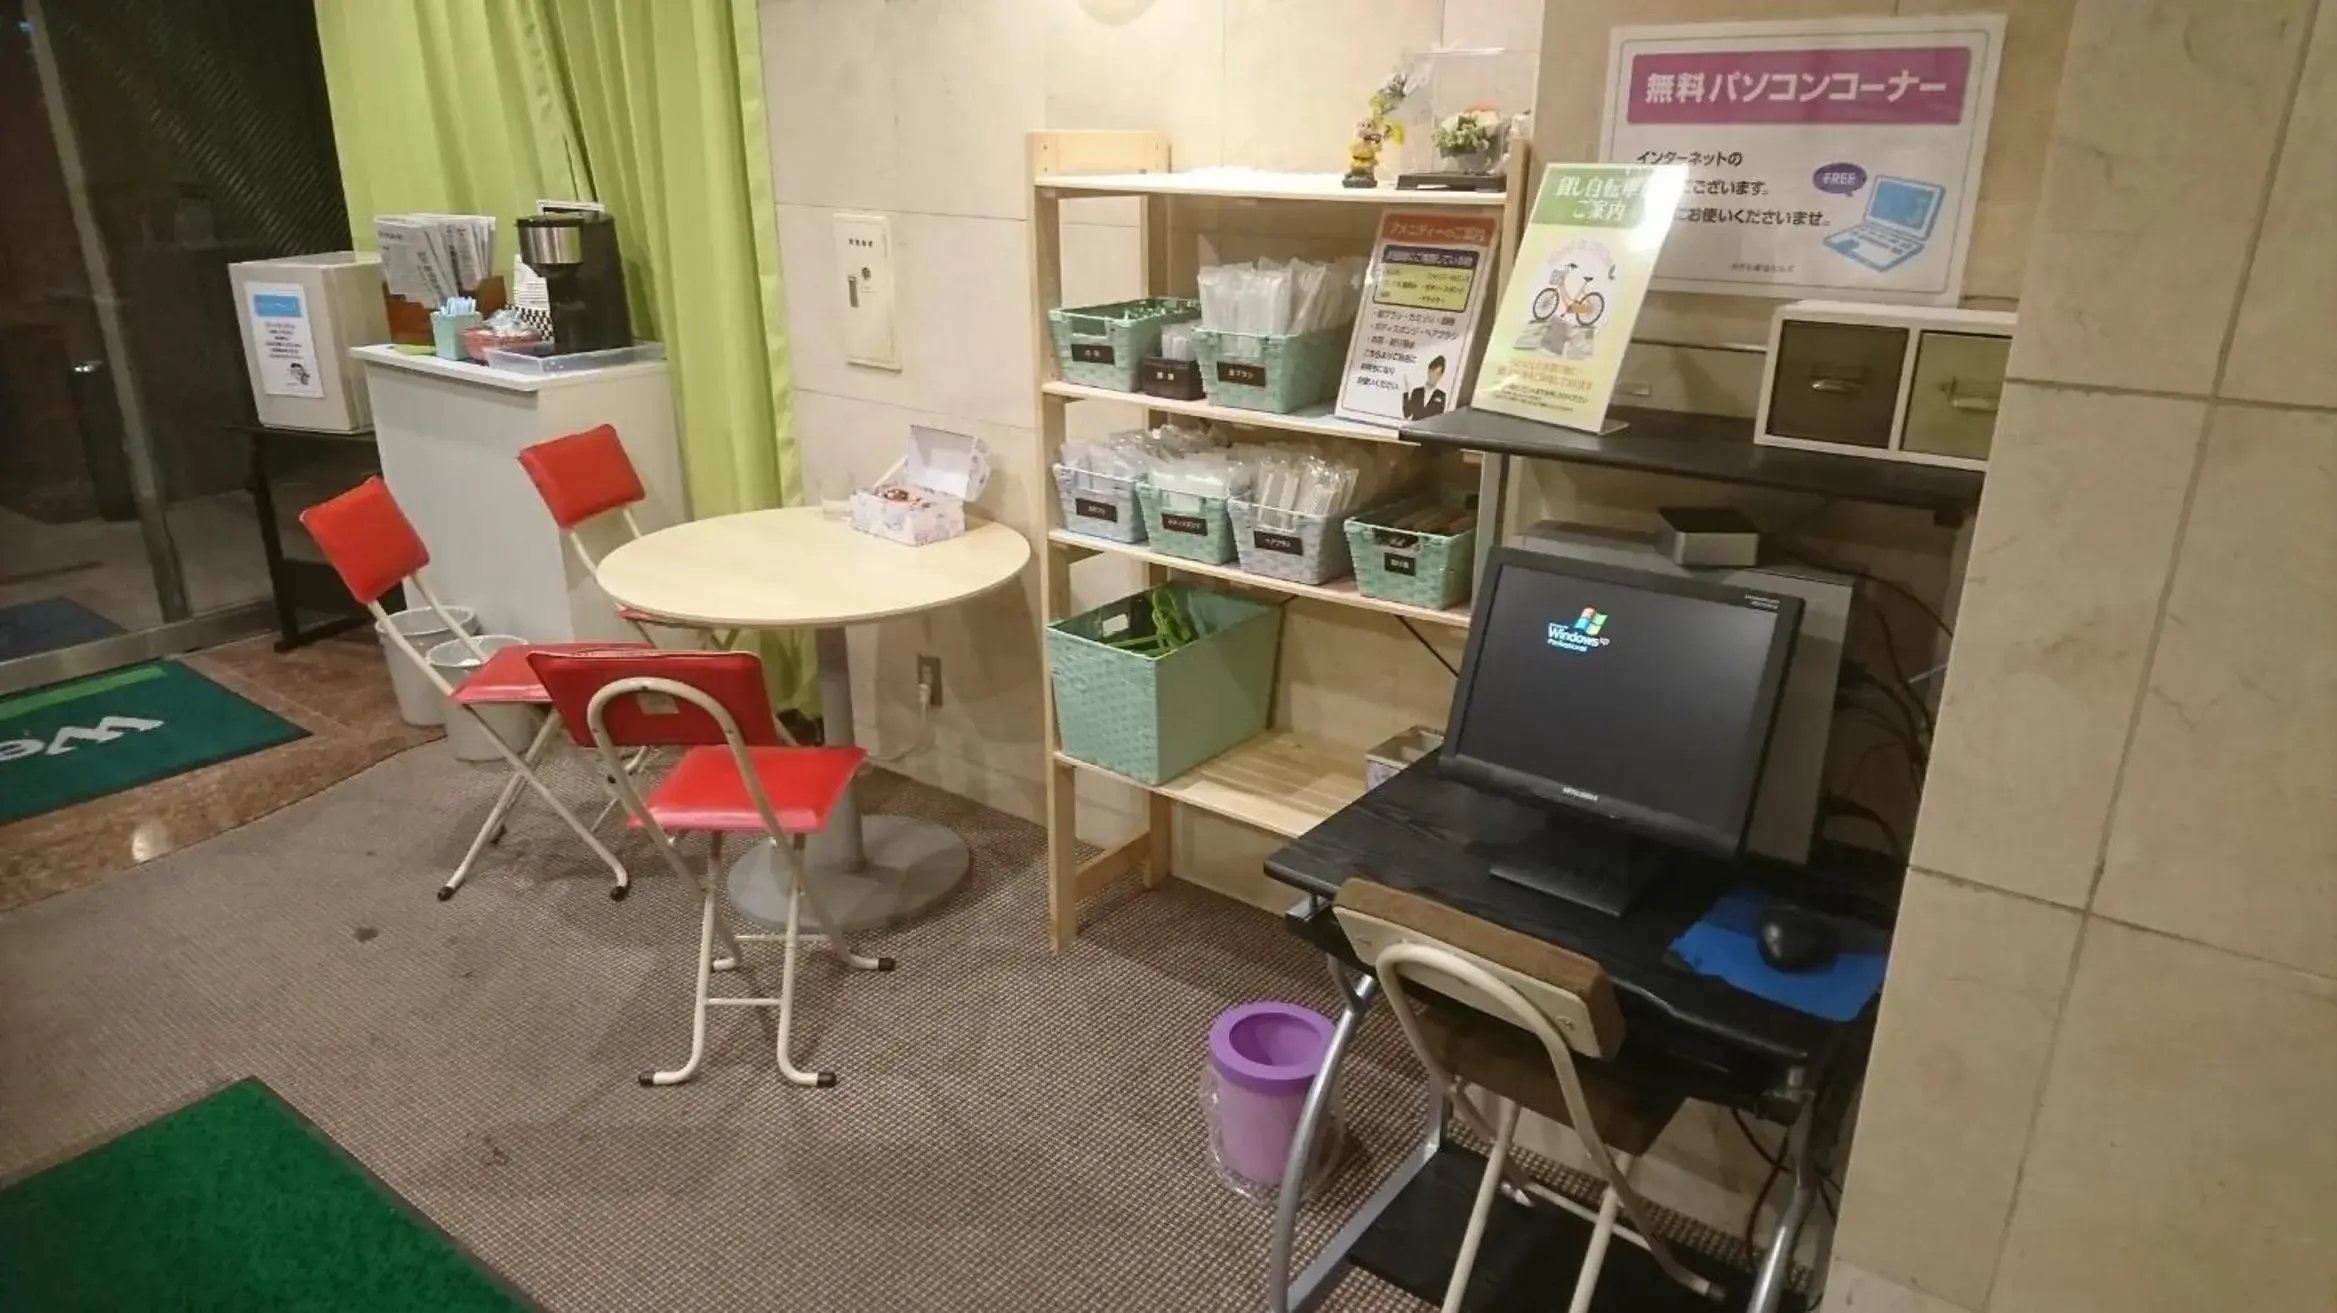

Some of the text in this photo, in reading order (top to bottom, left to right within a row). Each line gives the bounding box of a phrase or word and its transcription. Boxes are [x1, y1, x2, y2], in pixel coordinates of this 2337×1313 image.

[1645, 69, 1947, 104] 無料パソコンコーナー
[1636, 150, 1743, 168] インターネットの
[1822, 171, 1857, 185] FREE
[1572, 199, 1627, 221] ご案内
[1548, 624, 1599, 647] Windows
